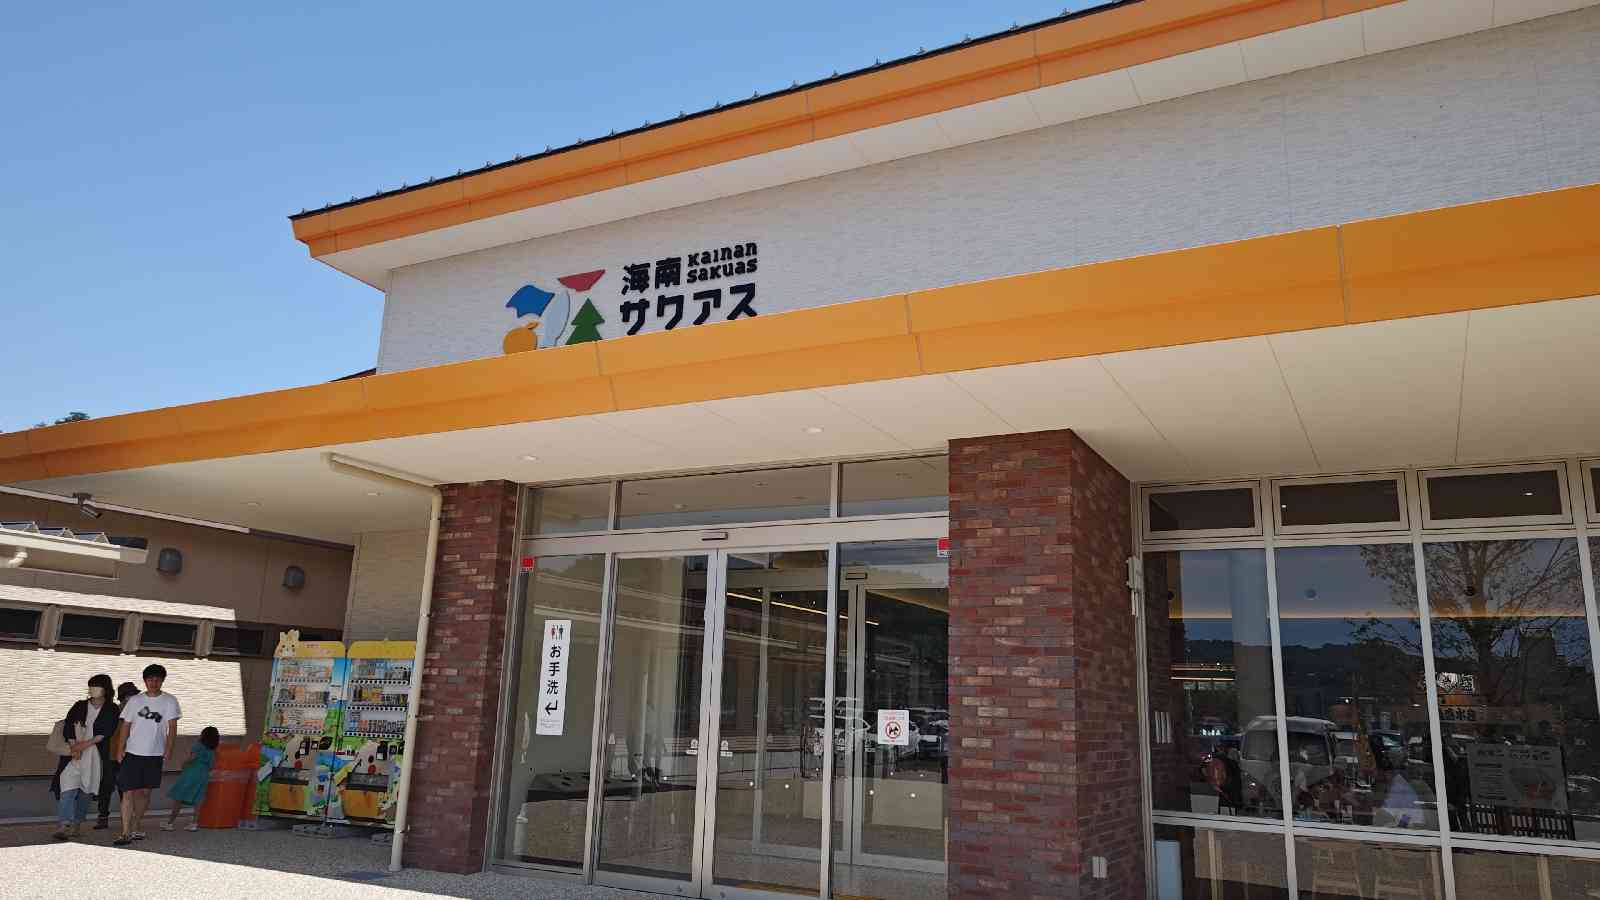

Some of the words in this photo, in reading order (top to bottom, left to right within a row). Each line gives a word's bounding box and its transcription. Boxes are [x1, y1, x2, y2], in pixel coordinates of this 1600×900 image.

[621, 257, 682, 295] 海南
[620, 282, 758, 336] サクアス
[546, 644, 562, 695] お手洗
